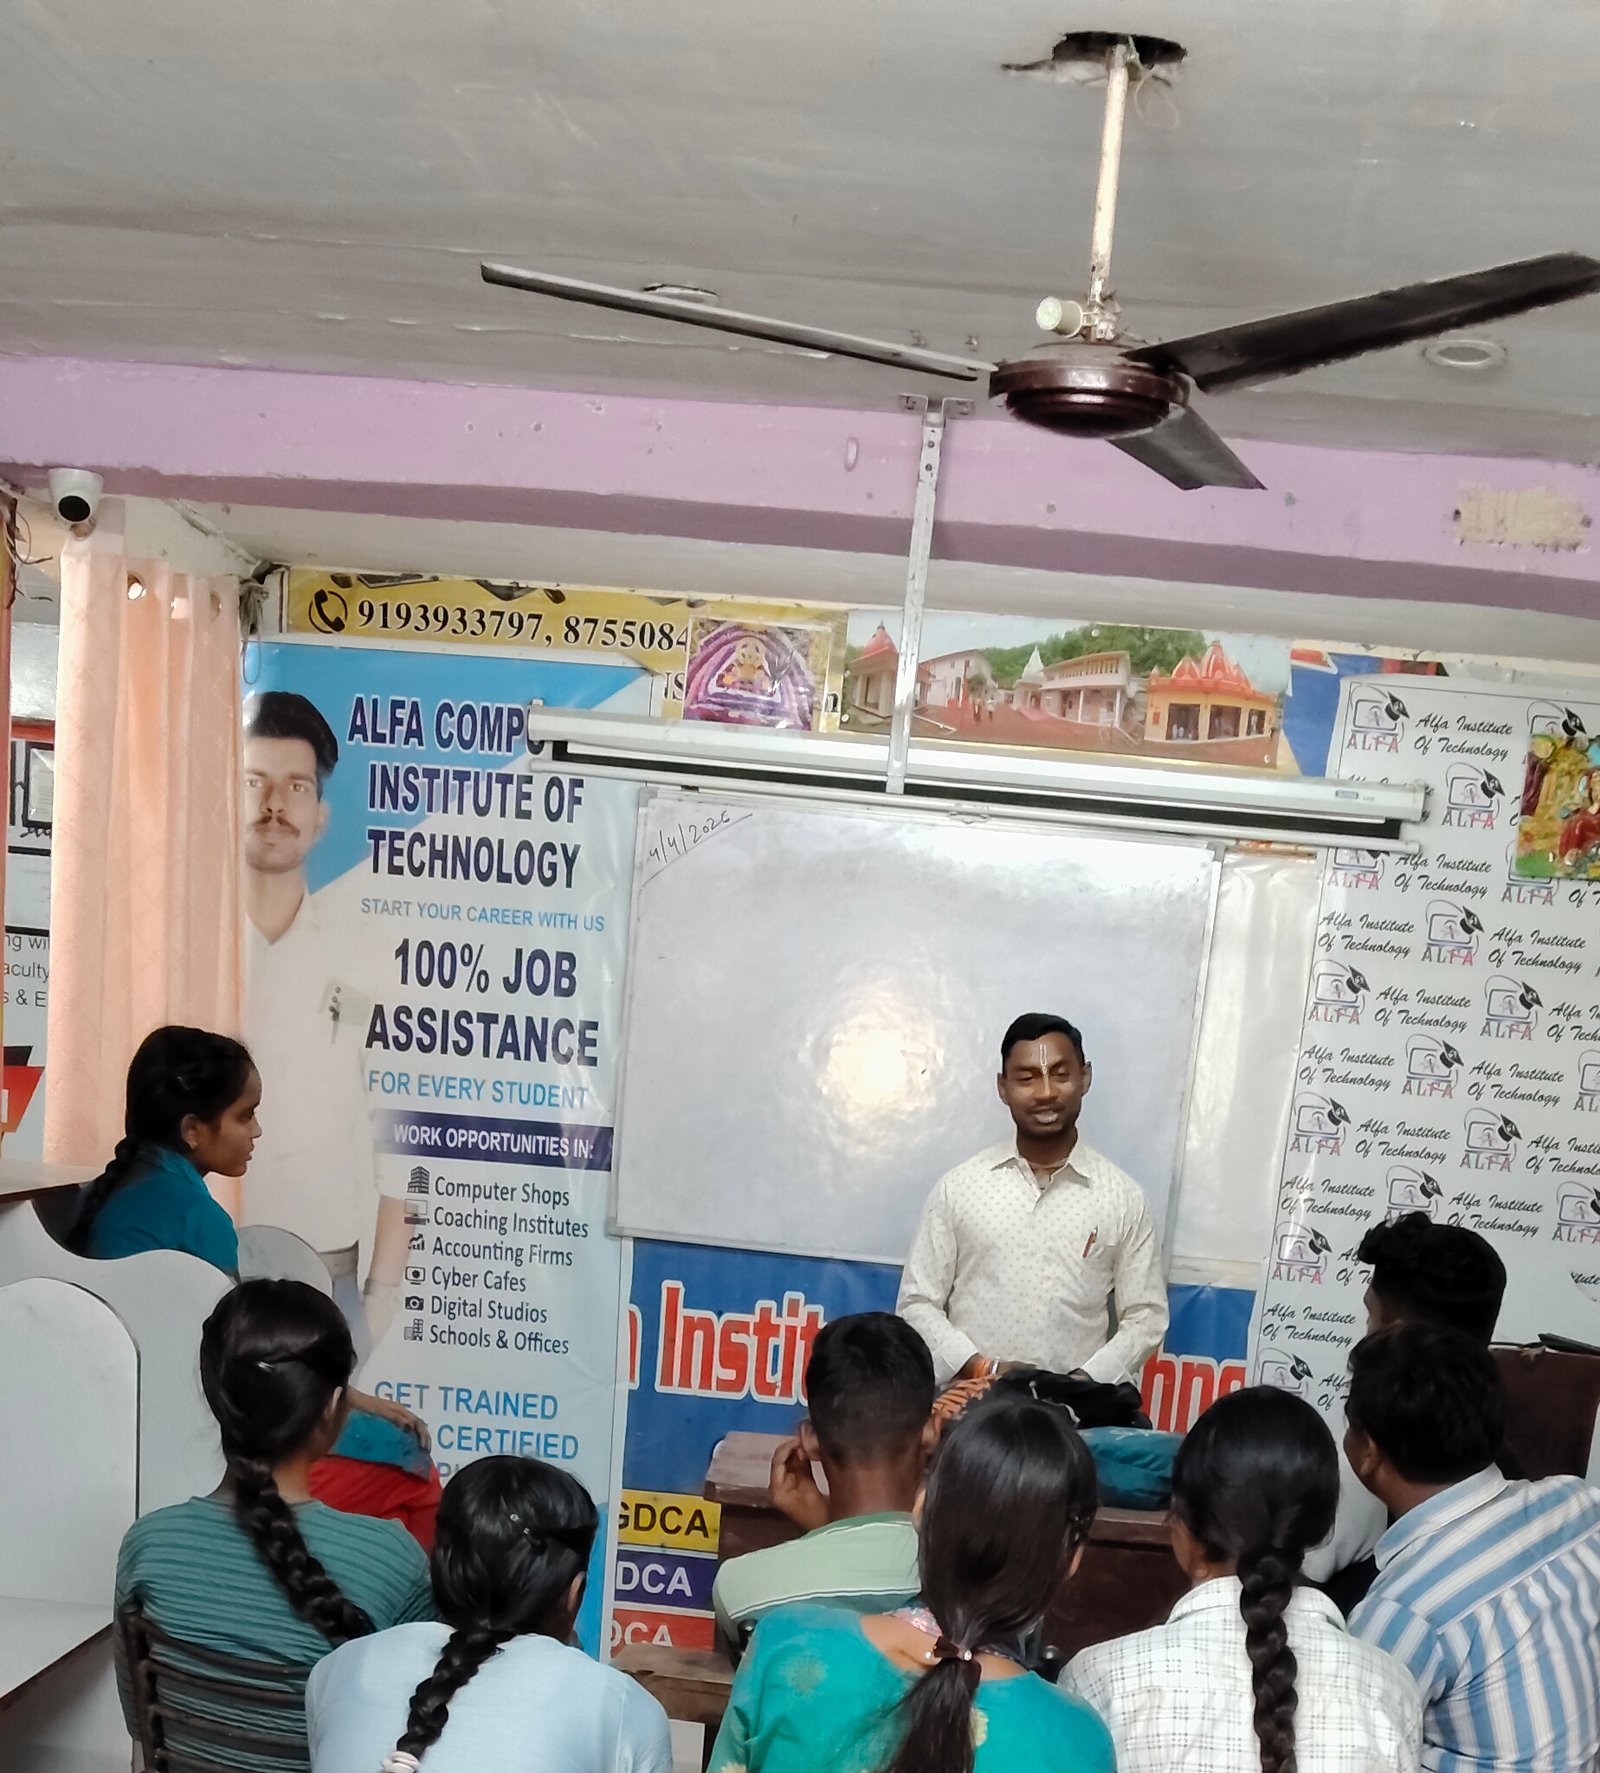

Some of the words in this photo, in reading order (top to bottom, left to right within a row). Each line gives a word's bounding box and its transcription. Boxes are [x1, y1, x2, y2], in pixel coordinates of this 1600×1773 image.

[358, 600, 552, 647] 9193933797,
[563, 616, 688, 652] 8755084
[348, 696, 424, 747] ALFA
[1415, 713, 1449, 734] Alfa
[1456, 715, 1513, 735] Institute
[1347, 733, 1399, 753] ALFA
[1414, 735, 1432, 755] Of
[1437, 737, 1509, 762] Technology
[368, 764, 534, 820] INSTITUTE
[544, 775, 584, 824] OF
[1441, 810, 1494, 830] ALFA
[367, 829, 581, 889] TECHNOLOGY
[1395, 852, 1429, 871] Alfa
[1436, 853, 1492, 873] Institute
[1327, 871, 1379, 890] ALFA
[1394, 873, 1412, 892] Of
[1417, 875, 1488, 899] Technology
[1501, 887, 1553, 906] ALFA
[1568, 889, 1587, 908] Of
[361, 898, 412, 917] START
[417, 903, 461, 920] YOUR
[467, 906, 533, 926] CAREER
[538, 912, 578, 930] WITH
[583, 916, 605, 931] US
[1318, 911, 1352, 931] Alfa
[1359, 914, 1415, 933] Institute
[1318, 932, 1335, 954] Of
[1341, 935, 1411, 960] Technology
[1489, 927, 1523, 947] Alfa
[1530, 929, 1586, 949] Institute
[394, 938, 490, 994] 100%
[502, 948, 577, 998] JOB
[1421, 947, 1473, 966] ALFA
[1488, 948, 1506, 968] Of
[1512, 951, 1583, 974] Technology
[1376, 986, 1410, 1006] Alfa
[1416, 988, 1471, 1008] Institute
[1308, 1005, 1360, 1025] ALFA
[1374, 1008, 1393, 1027] Of
[1397, 1009, 1468, 1033] Technology
[1548, 1001, 1582, 1021] Alfa
[365, 1003, 599, 1067] ASSISTANCE
[1480, 1021, 1532, 1040] ALFA
[1546, 1024, 1565, 1043] Of
[1300, 1044, 1333, 1064] Alfa
[1340, 1048, 1395, 1067] Institute
[1299, 1066, 1318, 1085] Of
[1322, 1068, 1392, 1092] Technology
[1469, 1060, 1502, 1080] Alfa
[1509, 1063, 1565, 1083] Institute
[368, 1070, 411, 1096] FOR
[417, 1074, 487, 1101] EVERY
[491, 1080, 588, 1110] STUDENT
[1401, 1080, 1453, 1099] ALFA
[1467, 1082, 1486, 1101] Of
[1490, 1084, 1560, 1107] Technology
[1356, 1118, 1389, 1138] Alfa
[1395, 1121, 1451, 1140] Institute
[394, 1124, 442, 1146] WORK
[445, 1128, 570, 1157] OPPORTUNITIES
[573, 1138, 594, 1159] IN:
[1289, 1137, 1341, 1156] ALFA
[1355, 1139, 1374, 1158] Of
[1378, 1141, 1447, 1165] Technology
[1527, 1134, 1560, 1154] Alfa
[1459, 1153, 1511, 1172] ALFA
[1525, 1155, 1544, 1174] Of
[435, 1176, 517, 1203] Computer
[521, 1183, 570, 1210] Shops
[1321, 1178, 1376, 1197] Institute
[1281, 1196, 1298, 1216] Of
[1303, 1198, 1373, 1222] Technology
[1448, 1191, 1481, 1211] Alfa
[1488, 1195, 1544, 1213] Institute
[434, 1206, 508, 1236] Coaching
[513, 1213, 589, 1238] Institutes
[1470, 1214, 1540, 1238] Technology
[432, 1237, 524, 1267] Accounting
[529, 1244, 573, 1266] Firms
[432, 1266, 478, 1291] Cyber
[484, 1270, 526, 1292] Cafes
[1271, 1267, 1323, 1285] ALFA
[1336, 1268, 1354, 1287] Of
[431, 1295, 482, 1320] Digital
[487, 1300, 547, 1323] Studios
[1263, 1303, 1296, 1322] Alfa
[1303, 1306, 1356, 1325] Institute
[430, 1324, 491, 1348] Schools
[496, 1329, 509, 1349] &
[514, 1332, 569, 1354] Offices
[1263, 1323, 1281, 1341] Of
[1285, 1325, 1352, 1348] Technology
[374, 1381, 430, 1409] GET
[438, 1386, 558, 1420] TRAINED
[1317, 1394, 1334, 1411] Of
[437, 1424, 579, 1460] CERTIFIED
[616, 1560, 693, 1598] DCA
